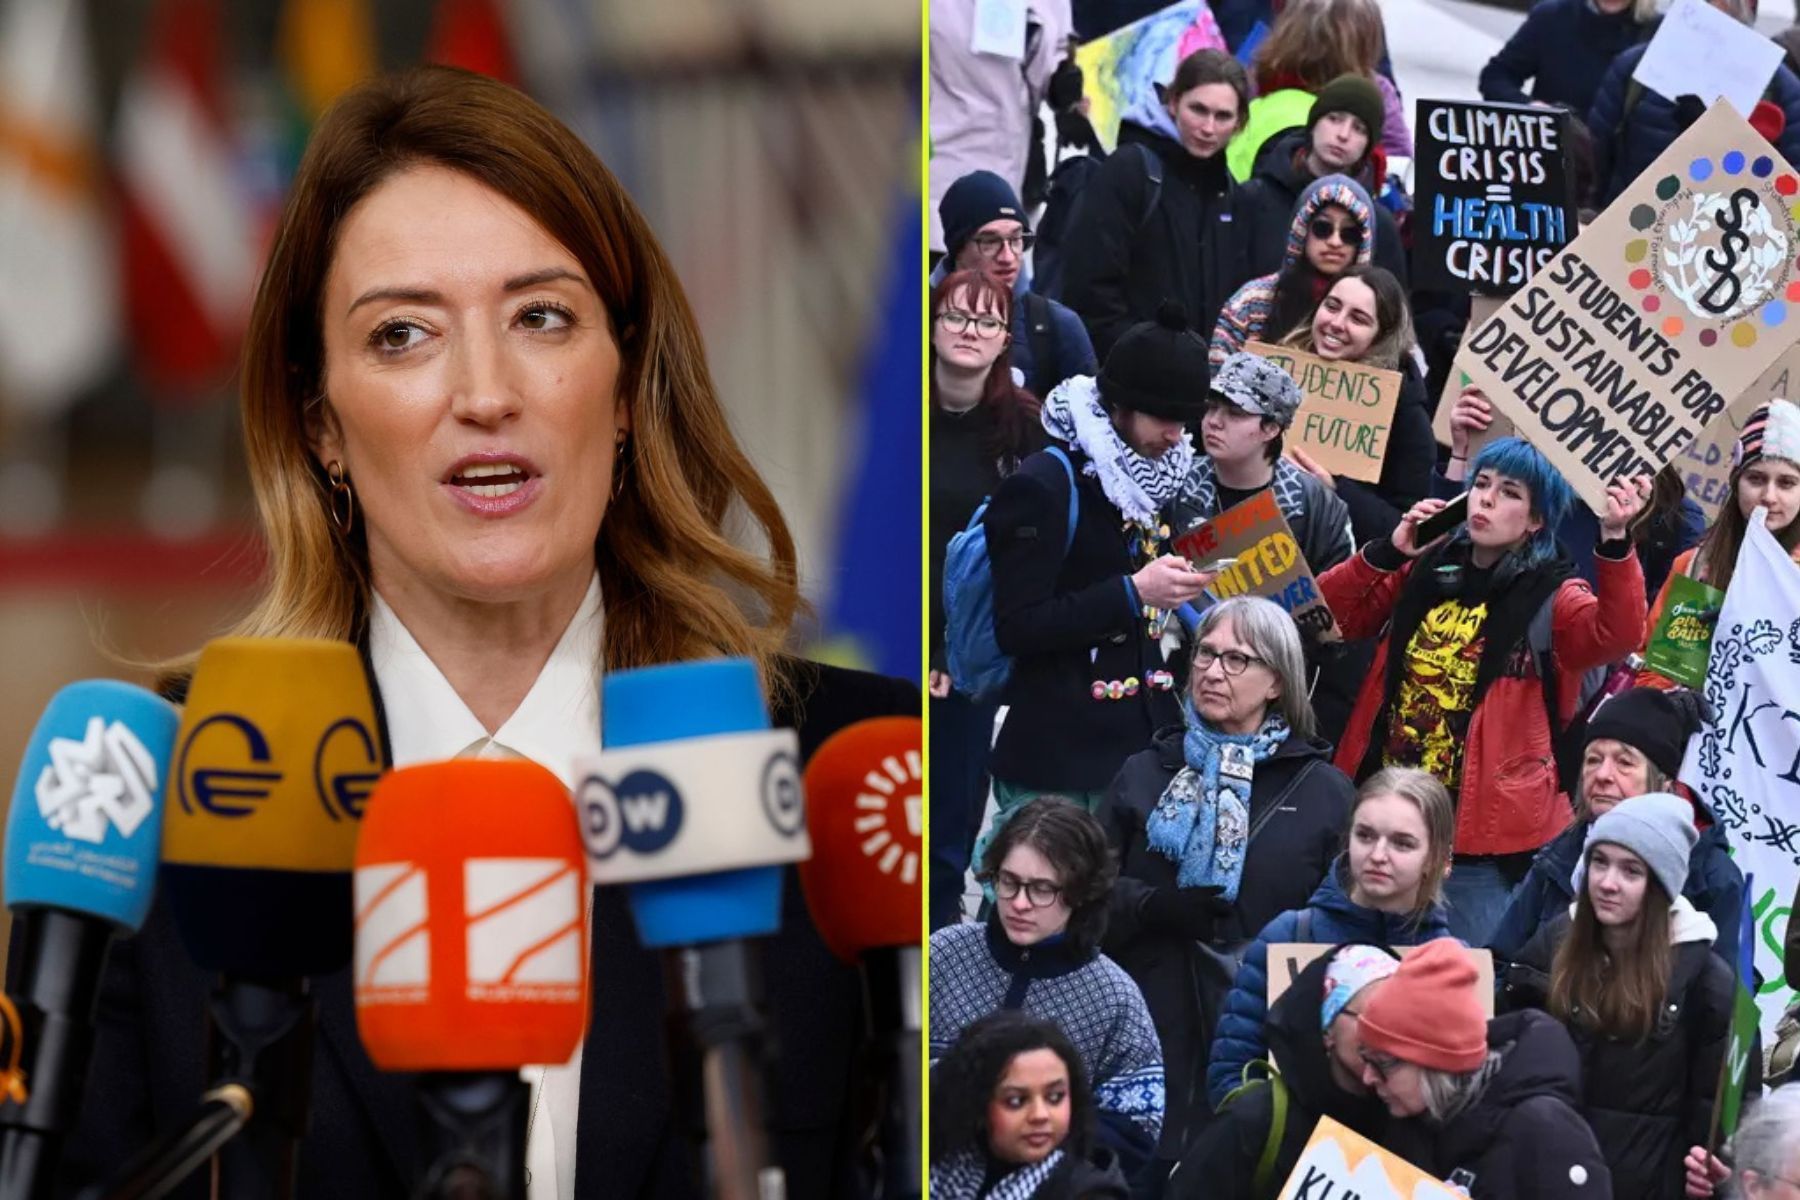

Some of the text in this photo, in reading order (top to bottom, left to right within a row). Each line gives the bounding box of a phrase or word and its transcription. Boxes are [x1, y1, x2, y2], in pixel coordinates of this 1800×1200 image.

[1428, 107, 1558, 150] CLIMATE
[1438, 147, 1546, 184] CRISIS
[1433, 193, 1566, 243] HEALTH
[1549, 252, 1725, 427] STUDENTS FOR
[1265, 355, 1381, 407] TUDENTS
[1510, 286, 1693, 465] SUSTAINABLE
[1468, 318, 1657, 487] DEVELOPMENT
[1303, 413, 1387, 459] FUTURE
[1267, 575, 1318, 613] VER
